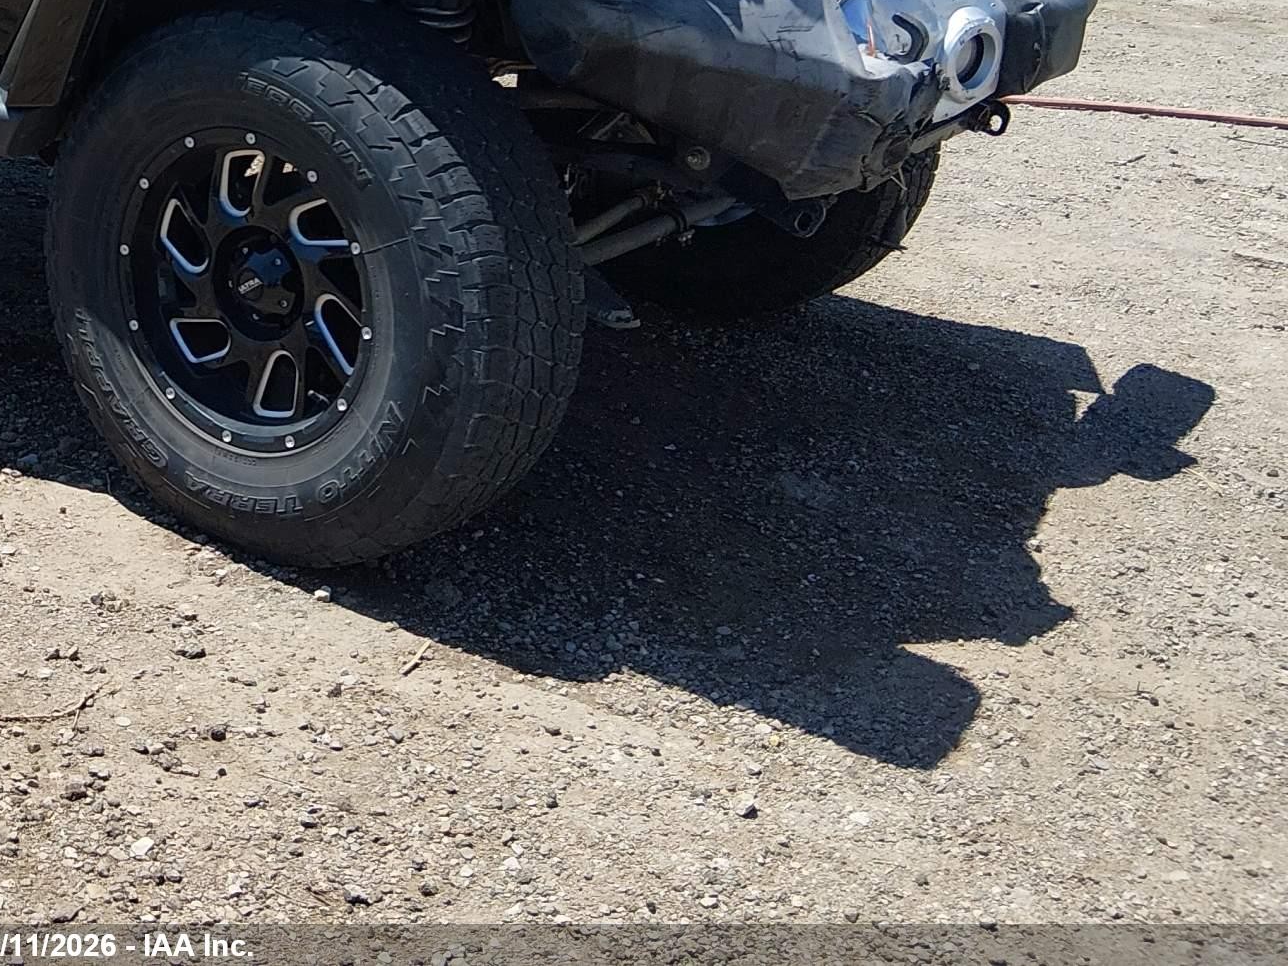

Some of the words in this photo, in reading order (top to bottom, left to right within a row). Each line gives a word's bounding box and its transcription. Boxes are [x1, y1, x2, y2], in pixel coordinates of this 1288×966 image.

[237, 279, 263, 295] ULTRA
[317, 396, 406, 506] NITTO
[183, 469, 304, 517] TERRA
